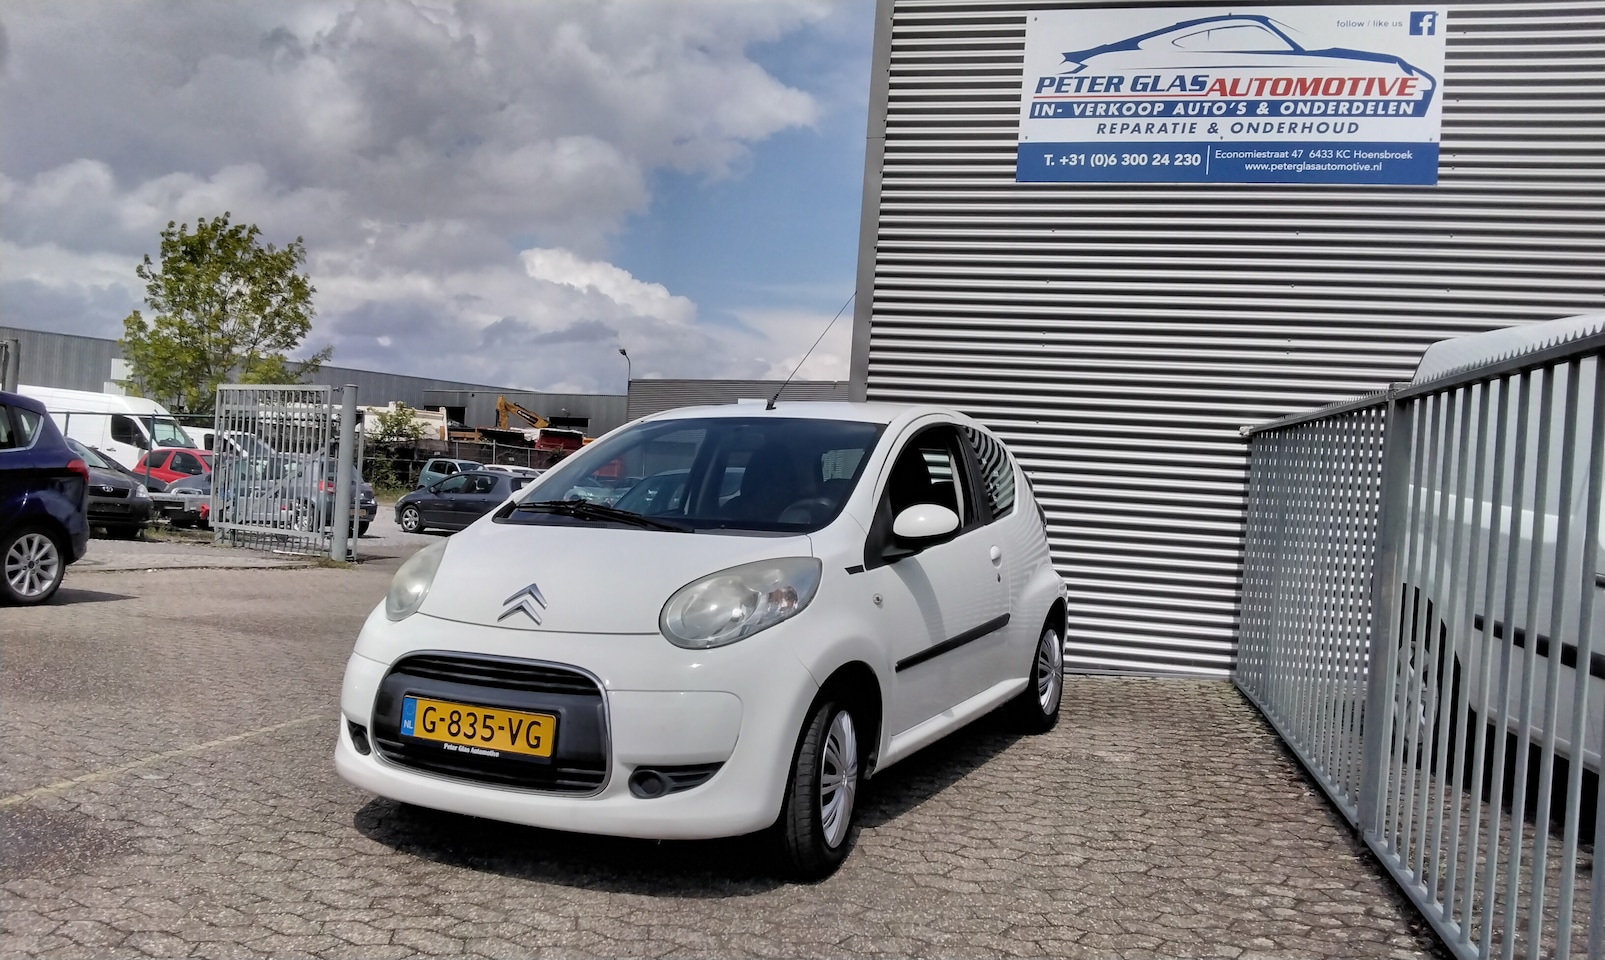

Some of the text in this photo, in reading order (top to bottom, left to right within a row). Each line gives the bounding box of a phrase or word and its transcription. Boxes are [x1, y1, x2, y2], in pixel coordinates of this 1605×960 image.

[1336, 19, 1365, 28] follow
[1372, 19, 1389, 28] like
[1035, 75, 1125, 94] PETER
[1034, 101, 1415, 116] IN- VERKOOP AUTO'S & ONDERDELEN
[1096, 122, 1360, 135] REPARATIE & ONDERHOUD
[1044, 153, 1202, 168] T. +31 (0)6 300 24 230
[1215, 150, 1413, 160] Economiestraat 47 6433 KC Hoensbroek
[1244, 162, 1383, 172] www.peterglasautomotive.nl
[404, 720, 413, 729] NL
[422, 706, 542, 749] G-835-VG
[443, 742, 458, 751] Peter
[470, 747, 500, 758] Automotive
